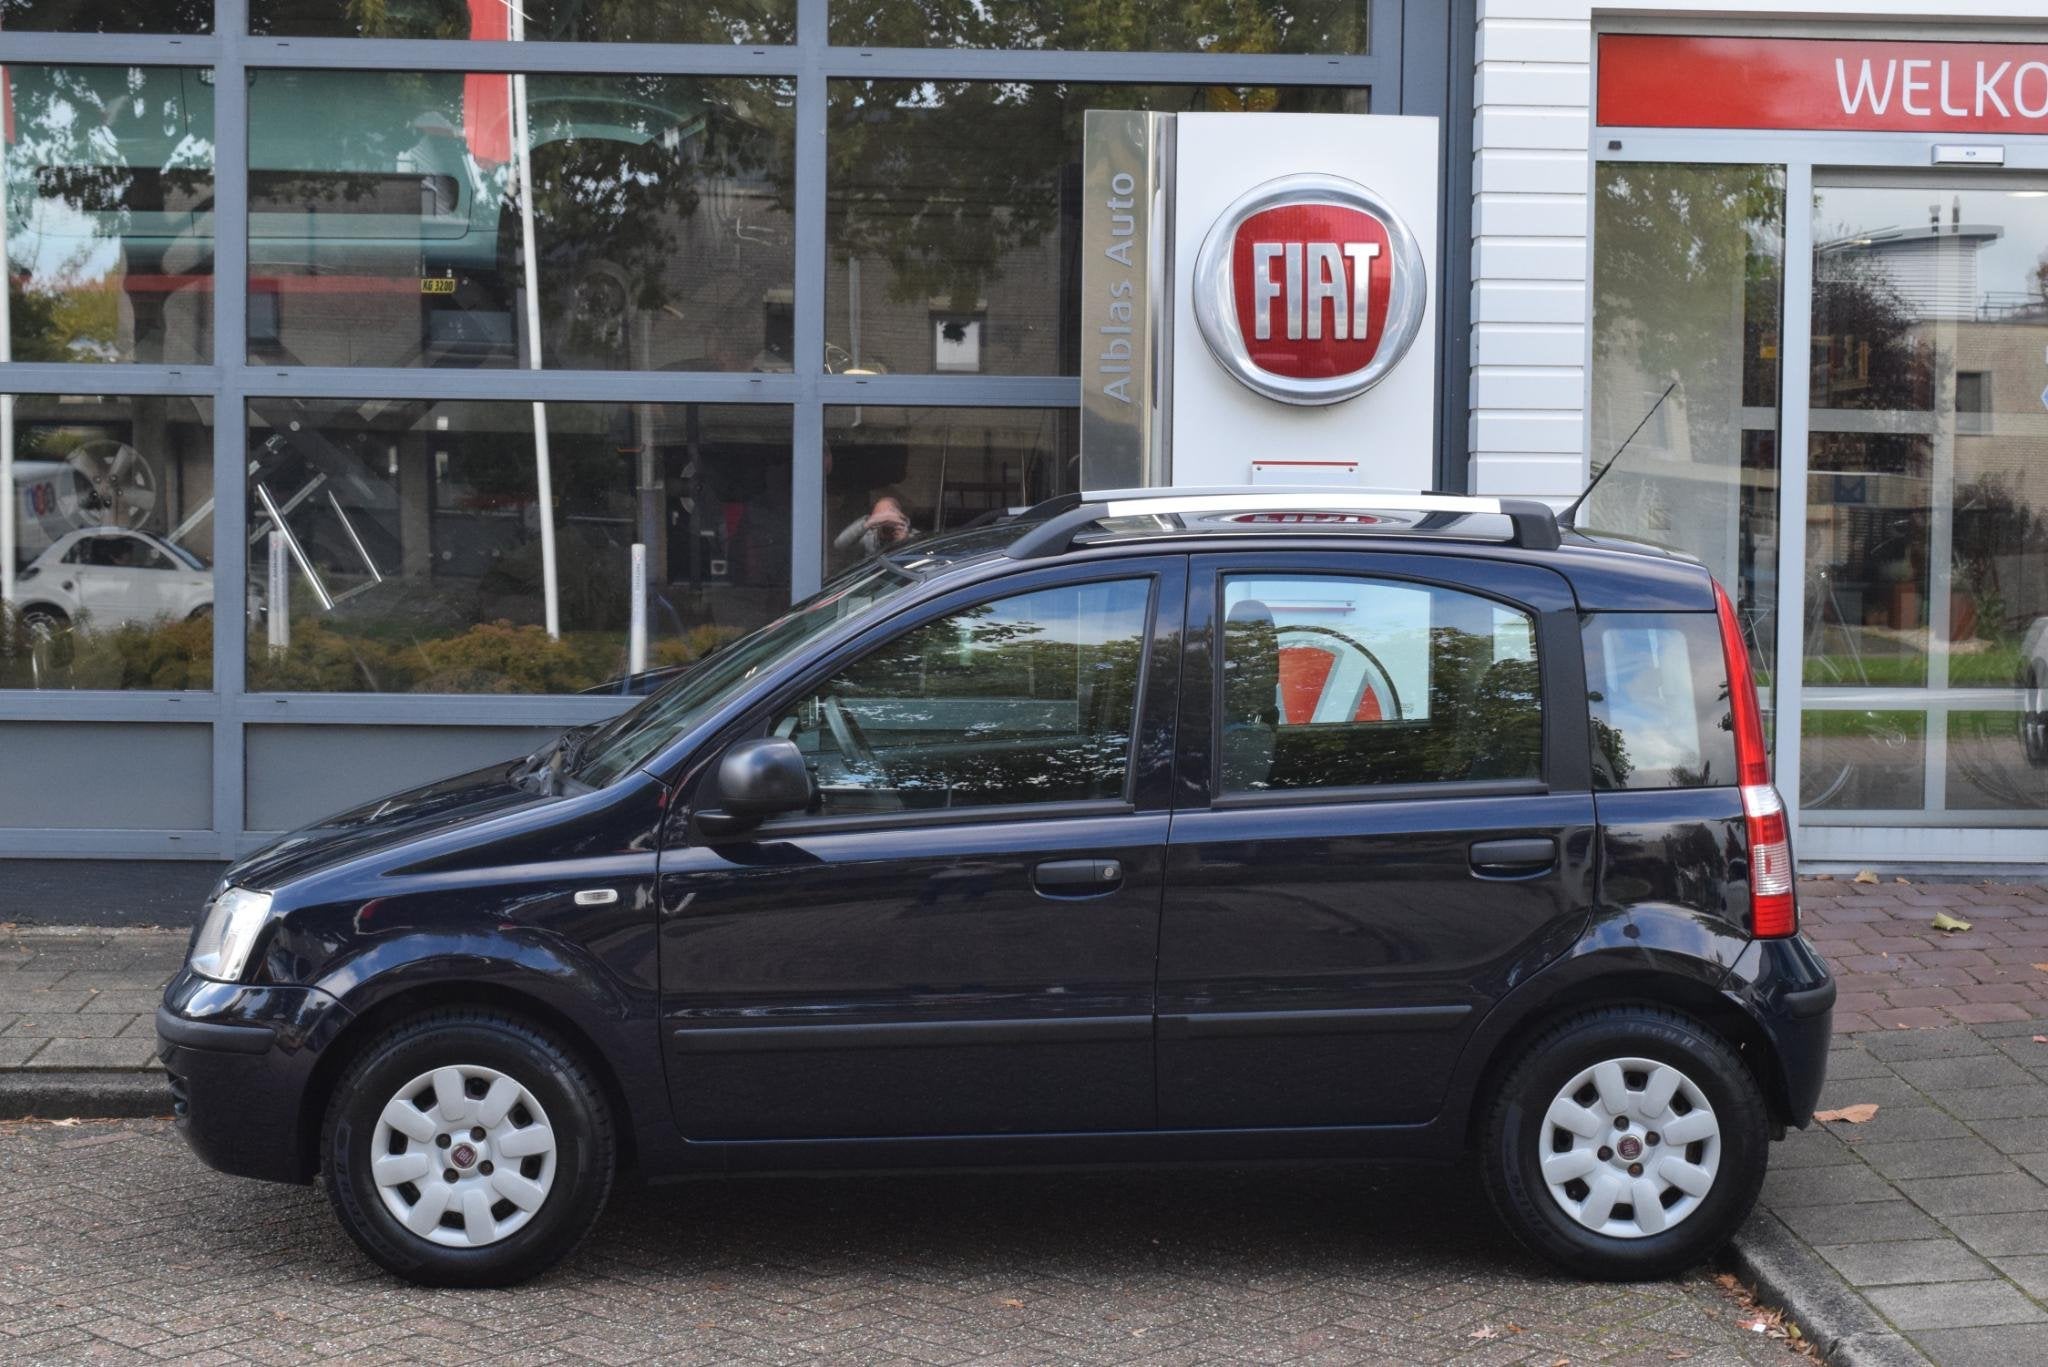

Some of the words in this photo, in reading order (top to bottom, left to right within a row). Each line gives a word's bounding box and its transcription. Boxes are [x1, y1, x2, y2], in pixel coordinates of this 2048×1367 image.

[1835, 58, 2048, 118] WELKO
[1105, 172, 1135, 267] Auto
[1252, 242, 1379, 340] FIAT
[1100, 280, 1133, 403] Alblas
